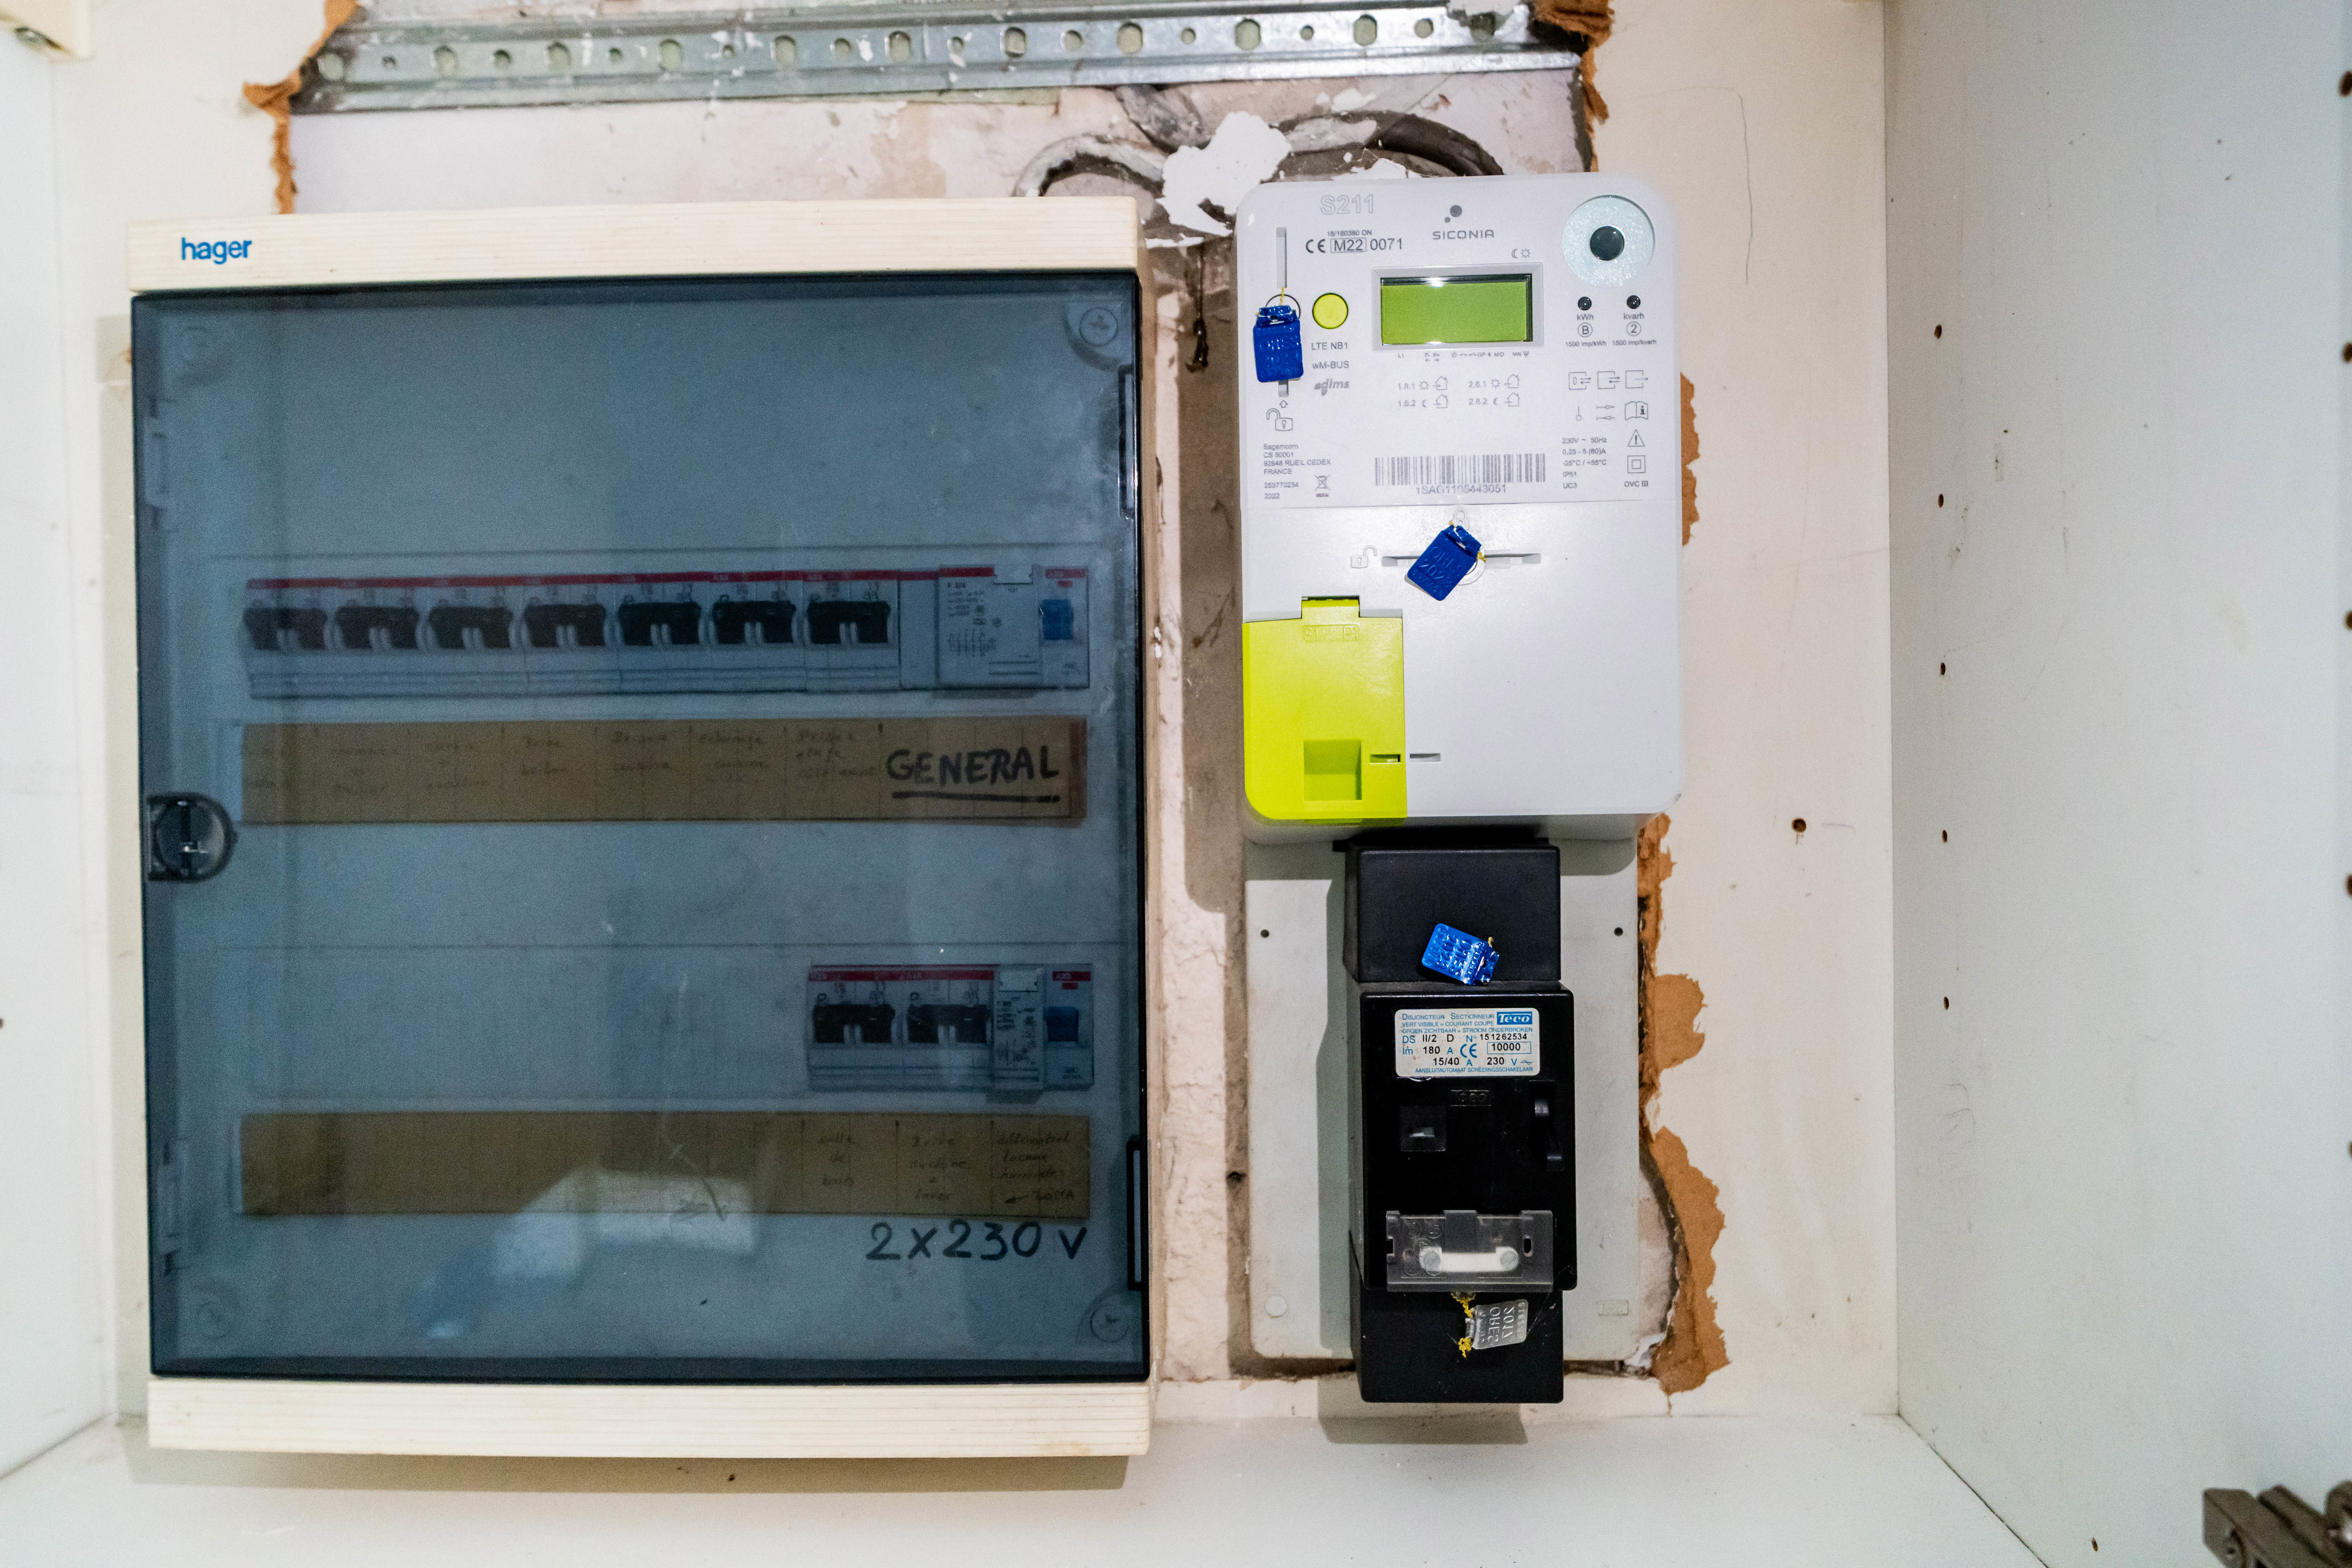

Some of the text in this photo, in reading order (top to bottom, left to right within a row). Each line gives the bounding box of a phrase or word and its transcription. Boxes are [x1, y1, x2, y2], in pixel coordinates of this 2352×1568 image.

[1320, 194, 1374, 215] S211
[1432, 229, 1495, 240] SICONIA
[1334, 238, 1363, 252] M22
[1370, 238, 1402, 250] 0071
[181, 237, 252, 265] hager
[1311, 341, 1348, 351] LTE NB1
[1312, 360, 1350, 369] wM-BUS
[886, 744, 1059, 787] GENERAL
[1498, 1013, 1531, 1024] Teco
[1402, 1035, 1416, 1043] DS
[1423, 1046, 1440, 1054] 180
[1492, 1042, 1521, 1051] 10000
[1433, 1057, 1459, 1066] 15/40
[1466, 1058, 1473, 1066] A
[1487, 1057, 1504, 1065] 230
